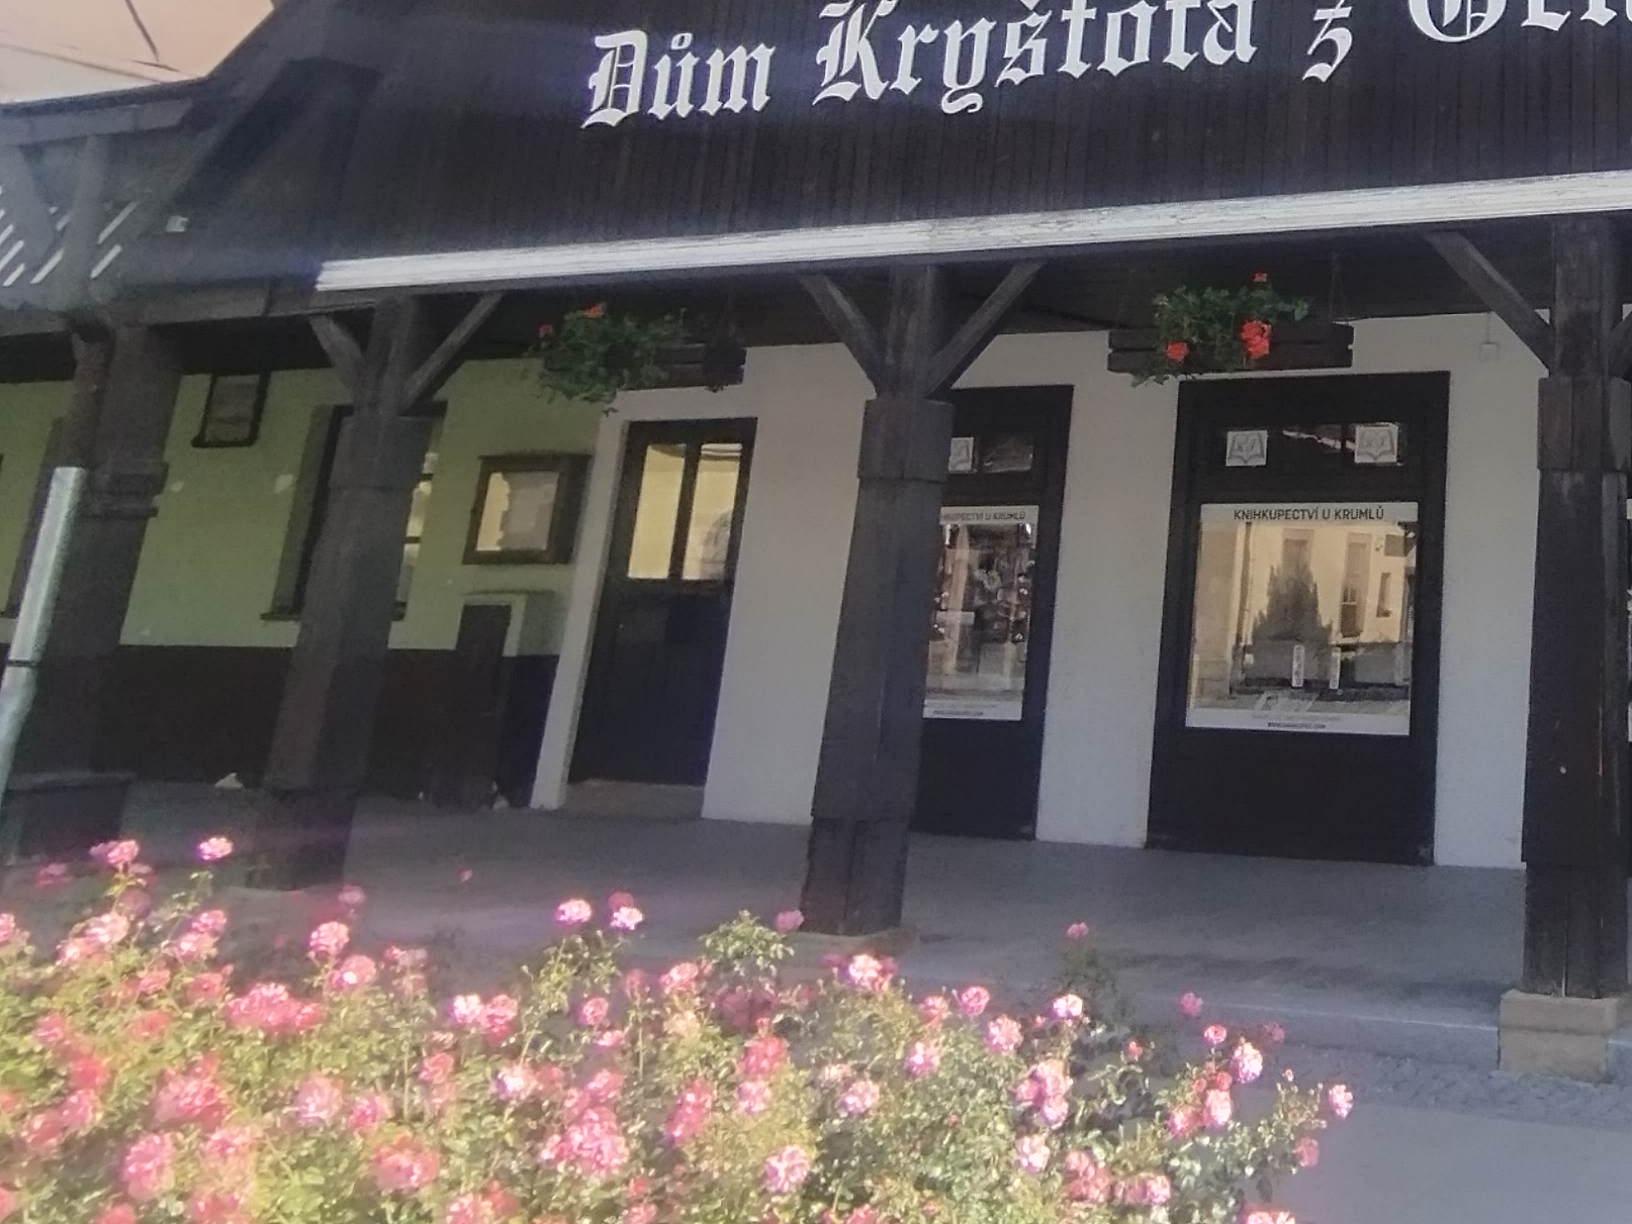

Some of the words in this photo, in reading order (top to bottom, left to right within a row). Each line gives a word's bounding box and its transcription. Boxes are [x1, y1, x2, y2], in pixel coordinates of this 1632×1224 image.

[581, 29, 776, 129] Dům
[1234, 507, 1319, 521] KNIHKUPECTVÍ
[1322, 508, 1331, 520] U
[1334, 506, 1384, 520] KRUMLŮ
